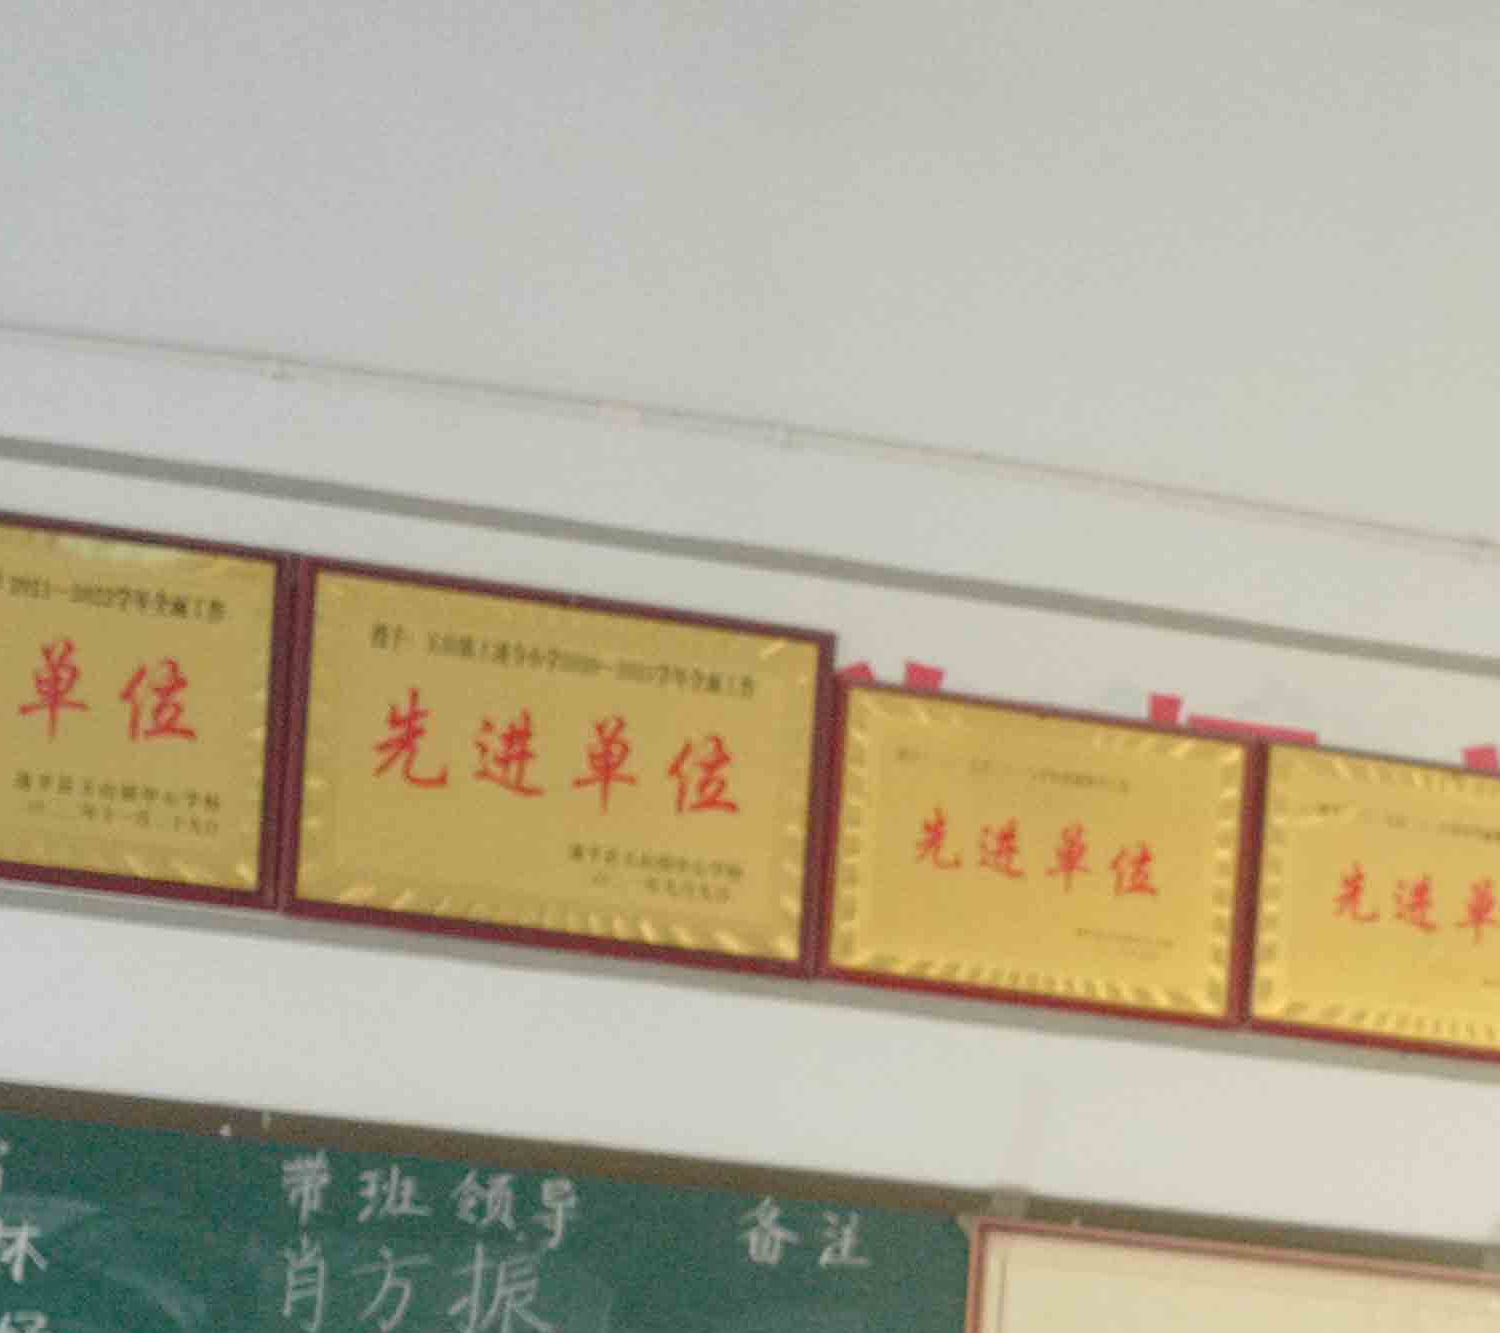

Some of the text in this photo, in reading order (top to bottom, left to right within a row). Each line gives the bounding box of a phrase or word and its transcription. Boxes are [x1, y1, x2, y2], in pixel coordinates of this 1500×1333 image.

[372, 688, 739, 814] 先进单位
[916, 807, 1158, 897] 先进单位
[280, 1150, 578, 1250] 带班领导
[738, 1195, 872, 1269] 备注
